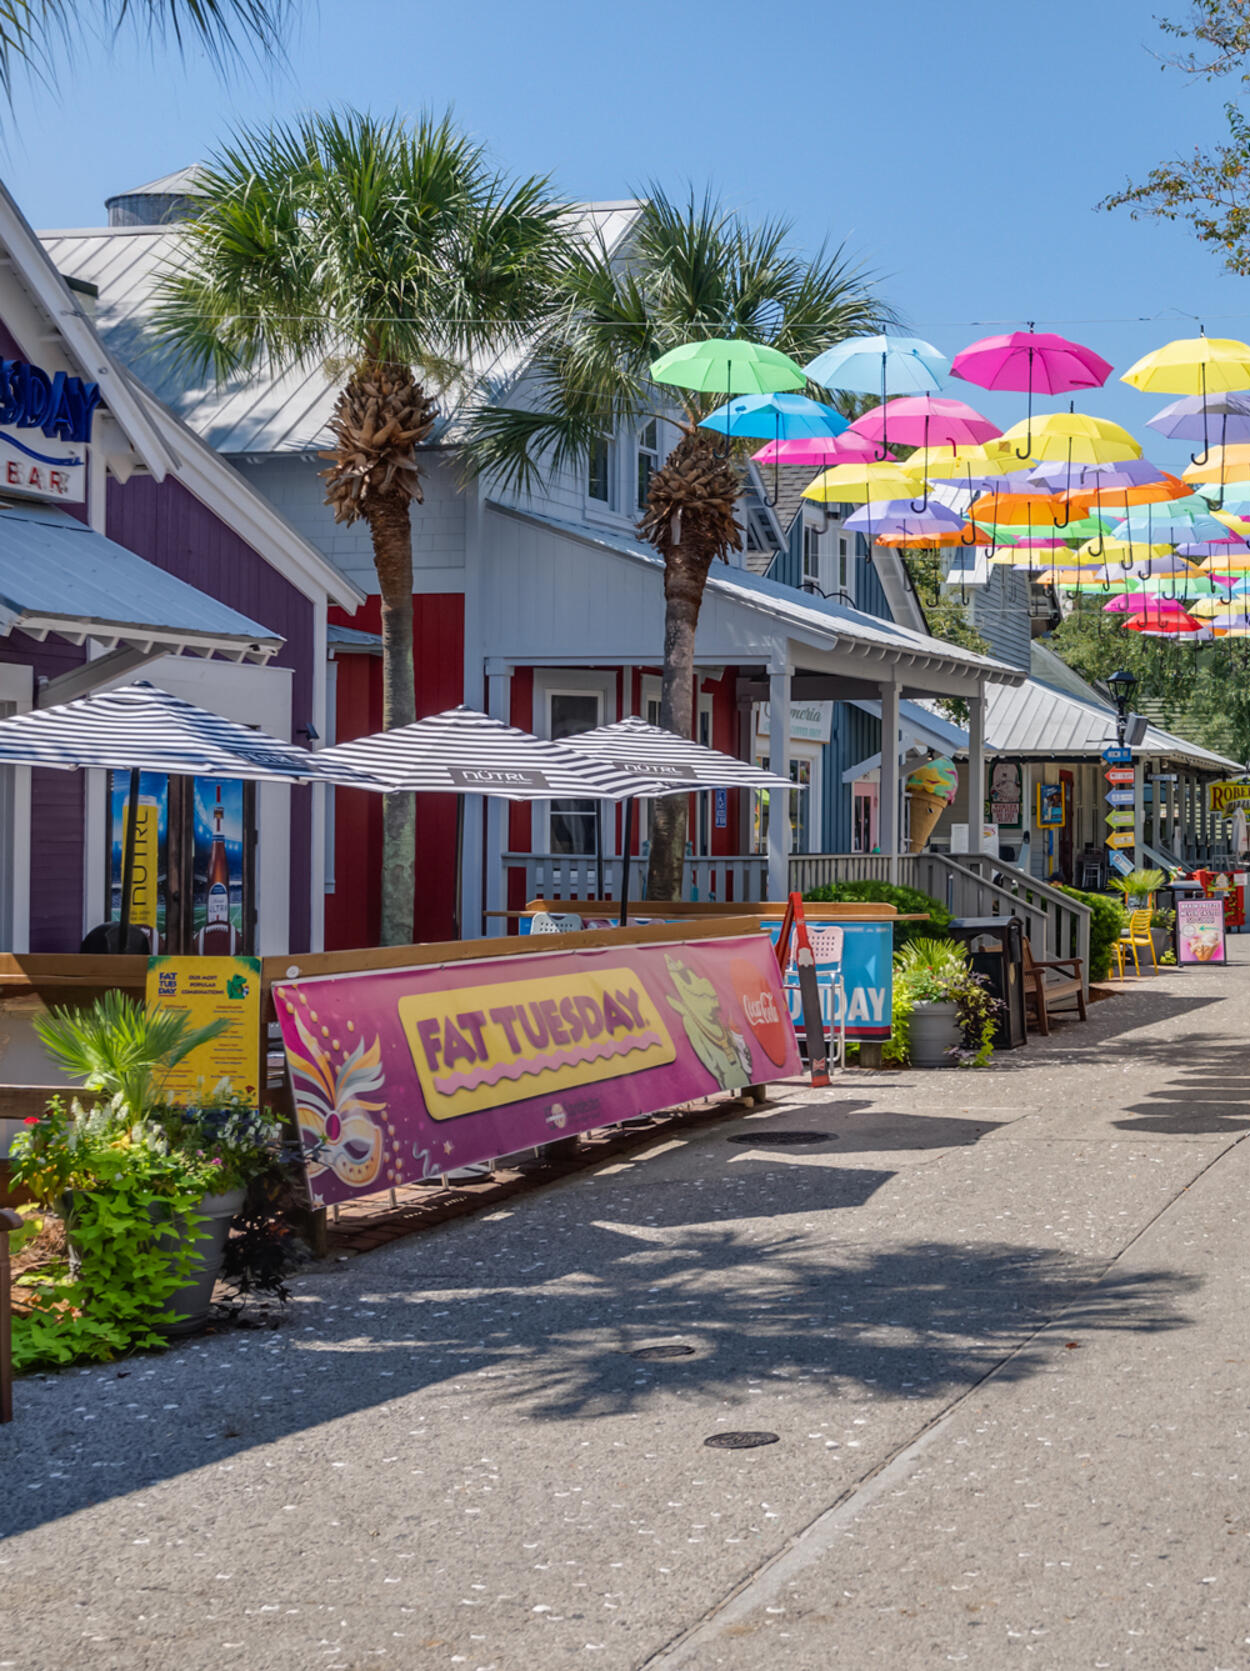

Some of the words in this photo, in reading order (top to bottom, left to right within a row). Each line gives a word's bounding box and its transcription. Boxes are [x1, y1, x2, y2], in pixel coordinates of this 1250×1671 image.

[7, 460, 63, 494] BAR
[159, 972, 177, 980] FAT
[416, 1010, 488, 1072] FAT
